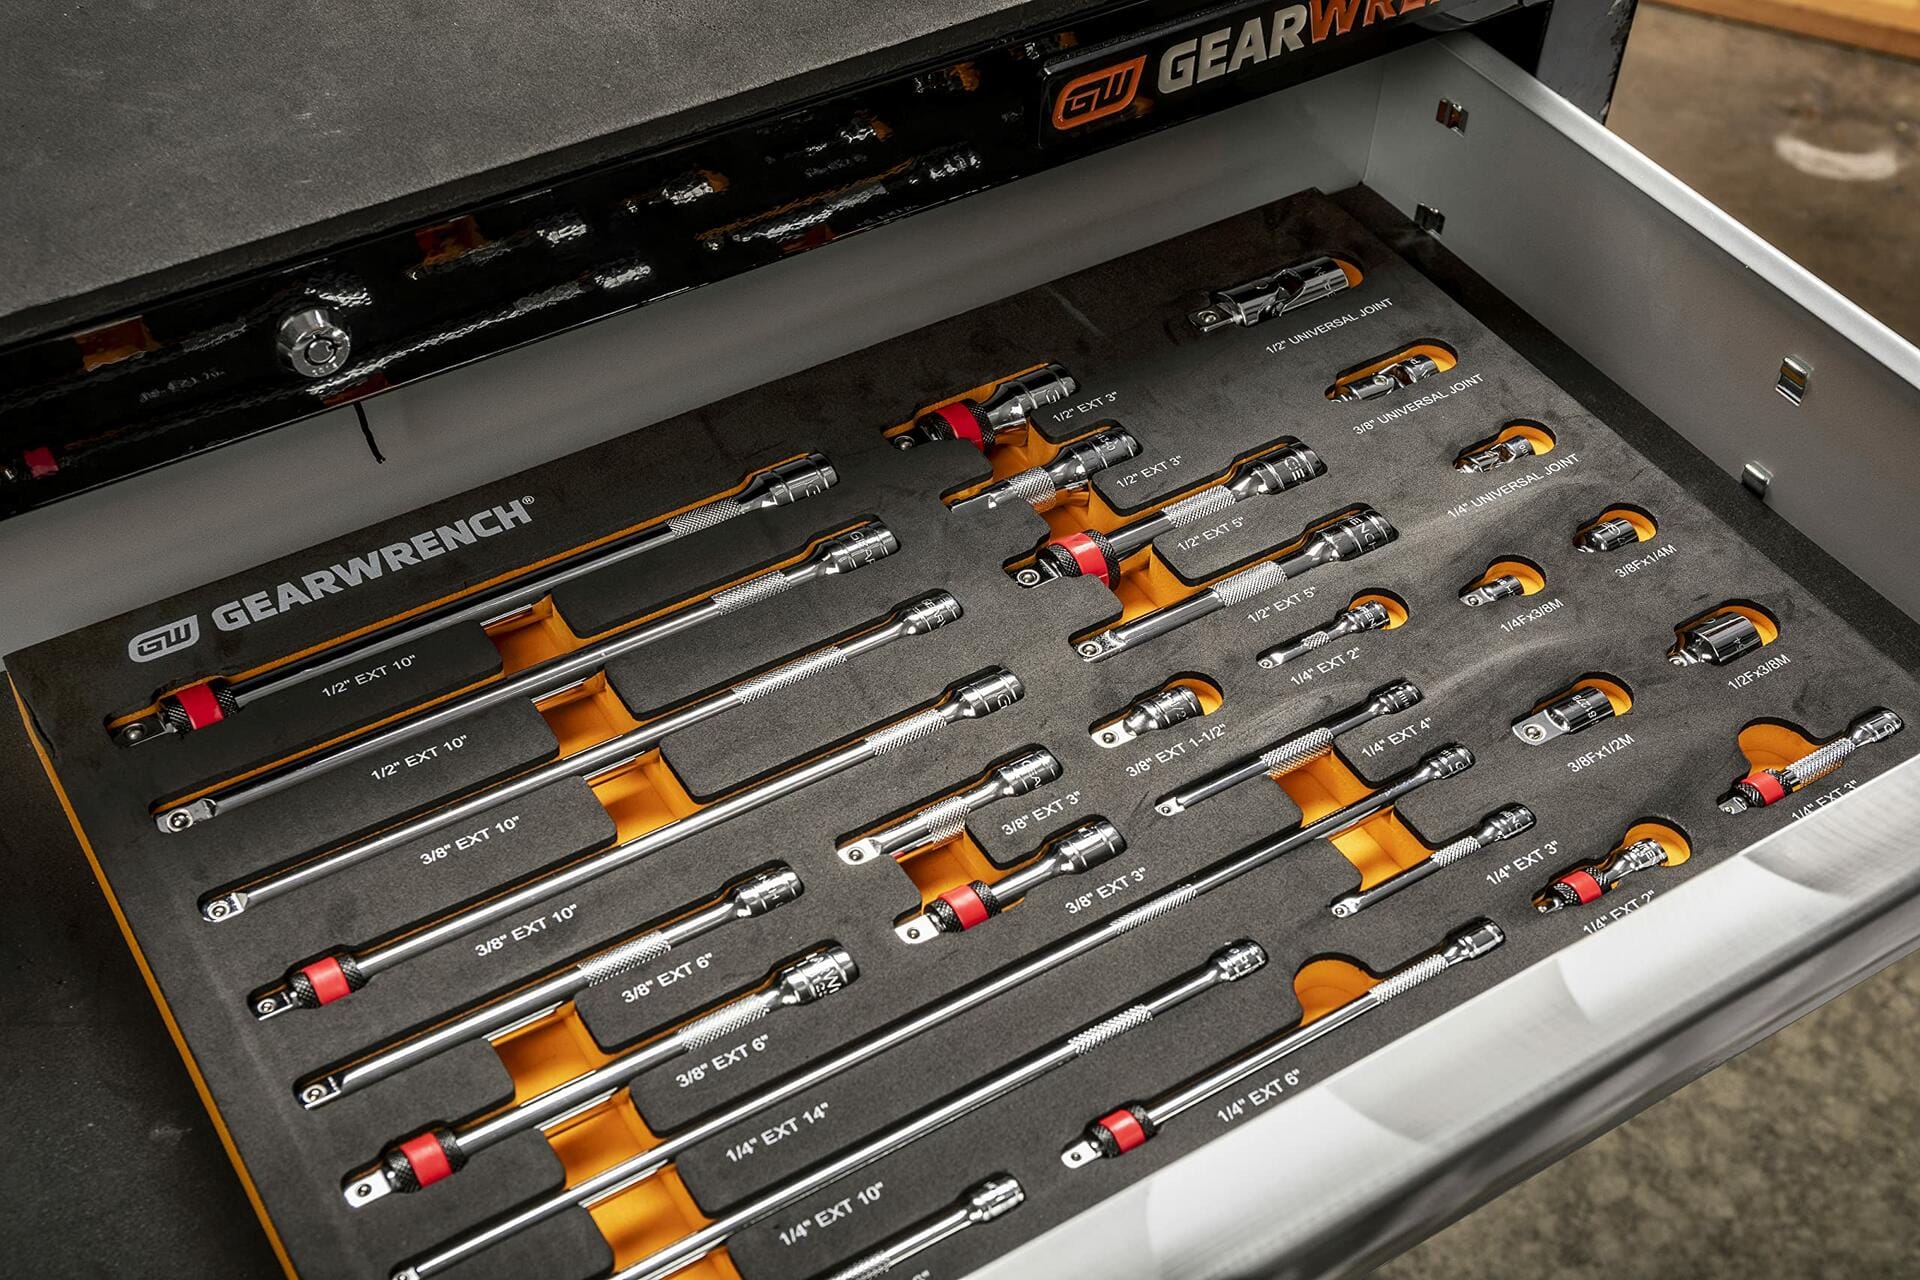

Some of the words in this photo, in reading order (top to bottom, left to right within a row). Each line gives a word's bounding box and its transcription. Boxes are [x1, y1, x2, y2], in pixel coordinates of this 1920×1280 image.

[1266, 340, 1286, 354] 1/2"
[1288, 314, 1359, 345] UNIVERSAL
[1360, 298, 1393, 317] JOINT
[1052, 408, 1074, 422] 1/2"
[1077, 396, 1103, 413] EXT
[1105, 391, 1117, 401] 3"
[1353, 419, 1375, 435] 3/8"
[1377, 391, 1449, 424] UNIVERSAL
[1449, 374, 1483, 395] JOINT
[1117, 473, 1138, 488] 1/2"
[1141, 461, 1168, 478] EXT
[1169, 455, 1182, 466] 3"
[1447, 503, 1468, 519] 1/4"
[1471, 472, 1544, 507] UNIVERSAL
[1544, 453, 1580, 476] JOINT
[1177, 536, 1200, 552] 1/2"
[1202, 523, 1231, 541] EXT
[1230, 516, 1244, 529] 5"
[1614, 543, 1677, 578] 3/8Fx1/4M
[1247, 606, 1270, 622] 1/2"
[1273, 593, 1301, 611] EXT
[1303, 586, 1315, 598] 5"
[1500, 598, 1564, 633] 1/4Fx3/8M
[322, 679, 350, 697] 1/2"
[354, 665, 387, 685] EXT
[392, 655, 416, 670] 10"
[1290, 668, 1315, 686] 1/4"
[1316, 656, 1346, 674] EXT
[1346, 647, 1360, 660] 2"
[1727, 653, 1791, 690] 1/2Fx3/8M
[371, 761, 400, 780] 1/2"
[404, 746, 438, 768] EXT
[443, 735, 468, 752] 10"
[1126, 757, 1152, 777] 3/8"
[1155, 744, 1186, 764] EXT
[1188, 722, 1226, 748] 1-1/2"
[1362, 738, 1385, 757] 1/4"
[1387, 725, 1418, 745] EXT
[1419, 716, 1432, 729] 4"
[1567, 732, 1635, 773] 3/8Fx1/2M
[1002, 814, 1030, 836] 3/8"
[1033, 801, 1064, 822] EXT
[1066, 790, 1082, 806] 3"
[1815, 788, 1842, 807] EXT
[420, 844, 451, 865] 3/8"
[455, 828, 490, 850] EXT
[495, 815, 521, 834] 10"
[1486, 865, 1512, 886] 1/4"
[1515, 848, 1544, 871] EXT
[1544, 840, 1558, 855] 3"
[1065, 890, 1093, 914] 3/8"
[1096, 878, 1129, 900] EXT
[1131, 867, 1146, 883] 3"
[1609, 898, 1639, 920] EXT
[475, 934, 507, 957] 3/8"
[511, 917, 547, 941] EXT
[551, 904, 577, 923] 10"
[622, 980, 653, 1003] 3/8"
[657, 961, 692, 987] EXT
[696, 952, 713, 968] 6"
[676, 1063, 708, 1087] 3/8"
[711, 1043, 748, 1071] EXT
[752, 1034, 769, 1052] 6"
[1217, 1098, 1246, 1123] 1/4"
[1248, 1078, 1283, 1107] EXT
[1284, 1068, 1301, 1086] 6"
[726, 1137, 757, 1163] 1/4"
[761, 1117, 799, 1145] EXT
[802, 1102, 829, 1125] 14"
[779, 1219, 811, 1246] 1/4"
[814, 1198, 852, 1228] EXT
[857, 1182, 884, 1206] 10"
